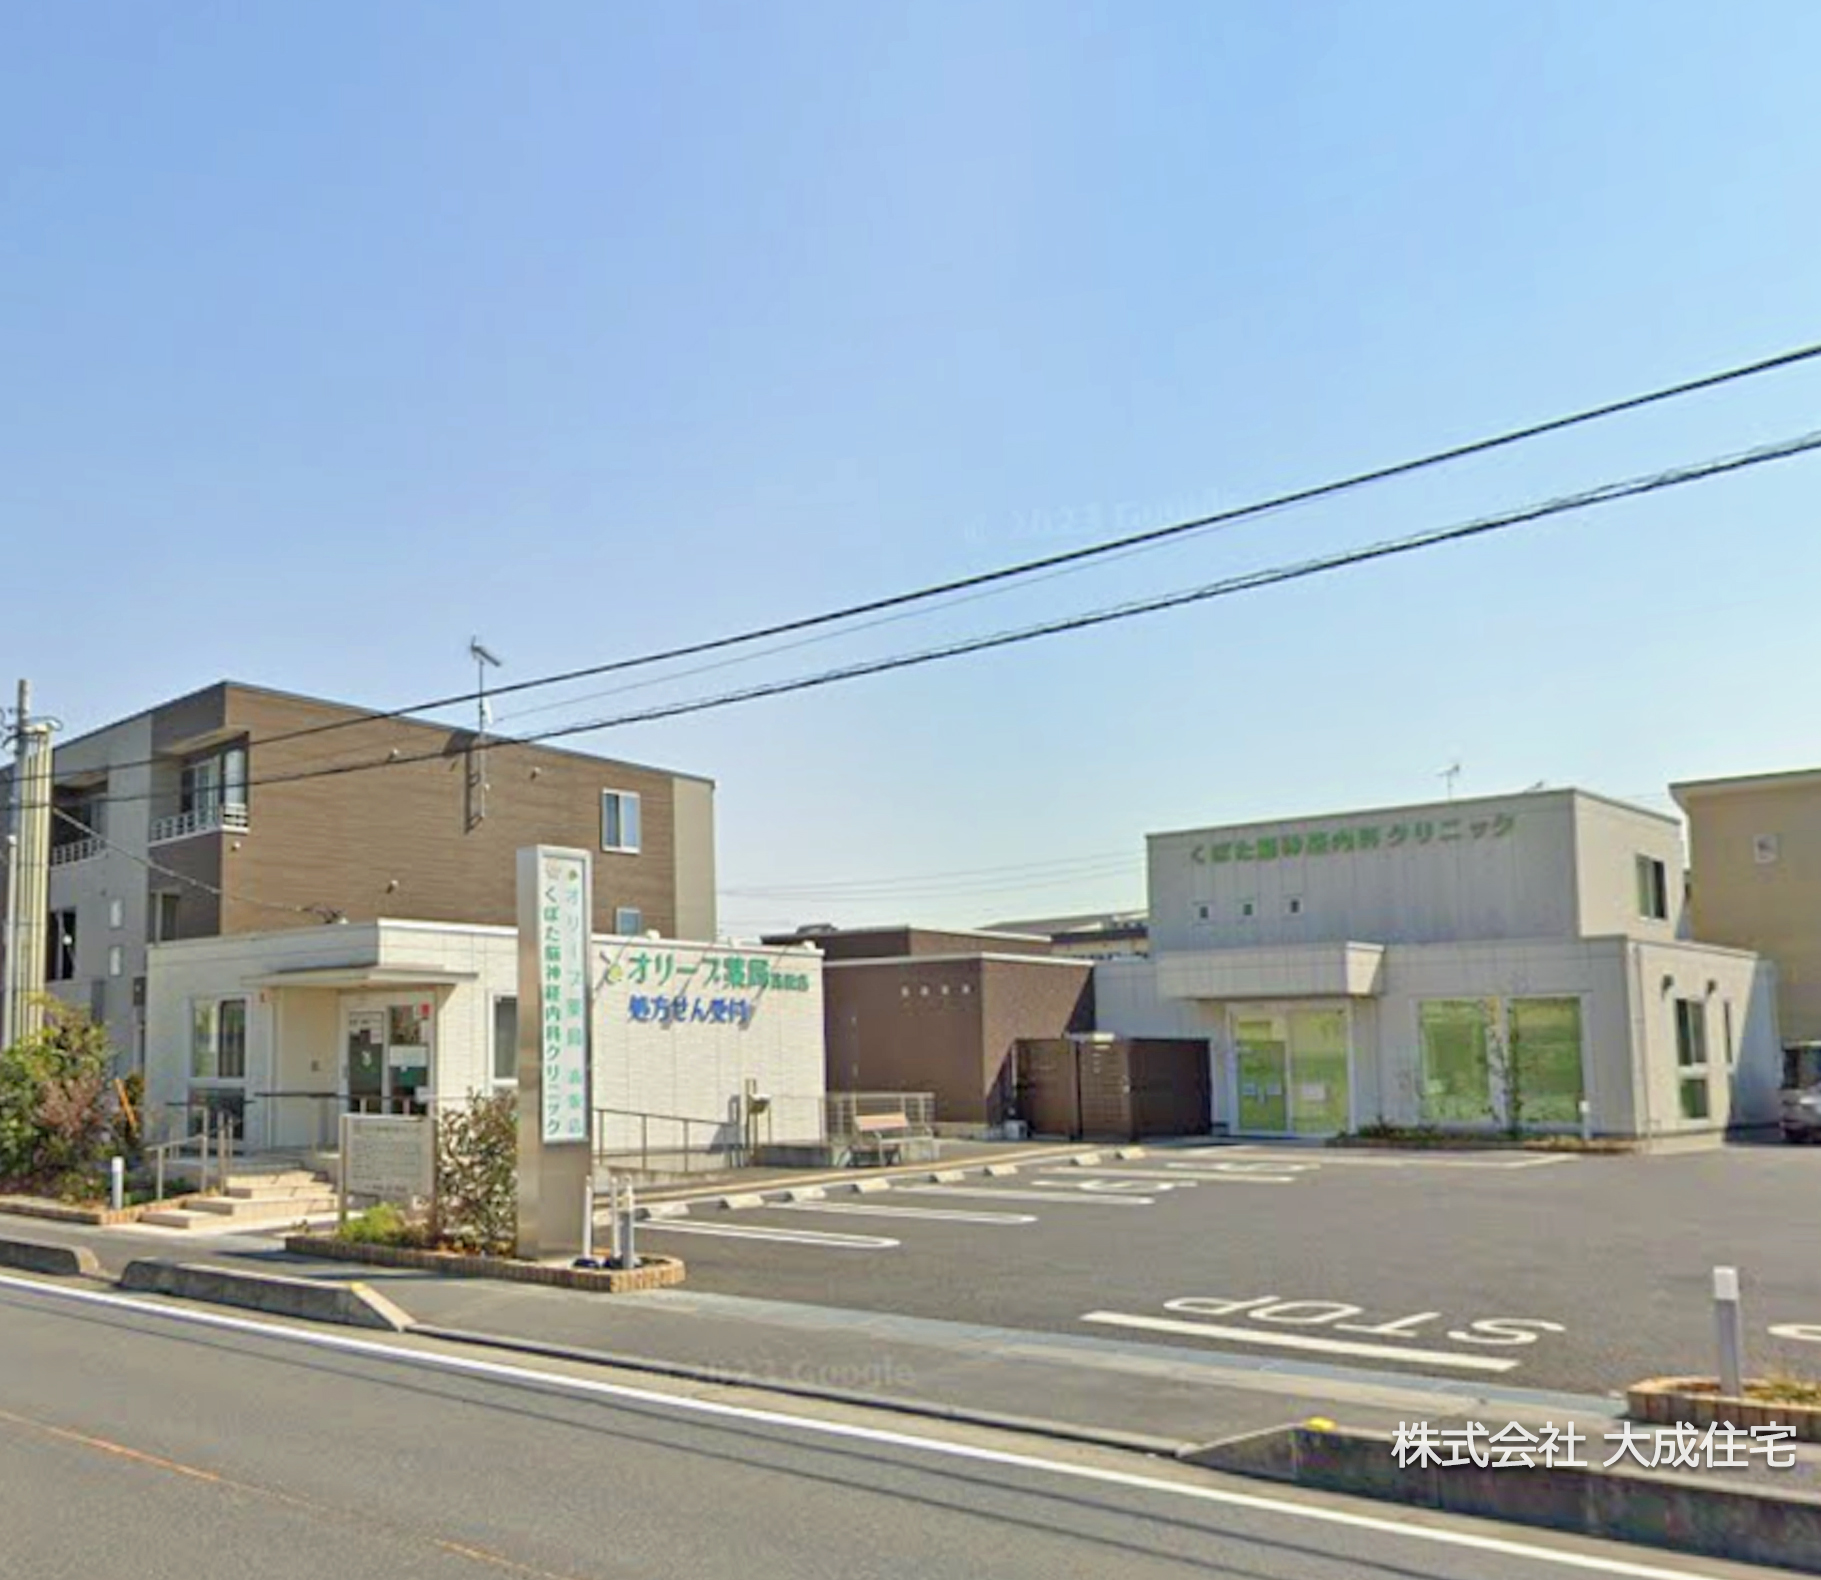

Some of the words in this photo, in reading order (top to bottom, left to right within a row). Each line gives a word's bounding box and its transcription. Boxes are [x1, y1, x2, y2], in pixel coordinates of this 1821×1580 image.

[543, 885, 561, 1135] くぼた脳神経内科クリニック
[629, 995, 752, 1023] 処方せん受付
[1163, 1295, 1566, 1345] STOP
